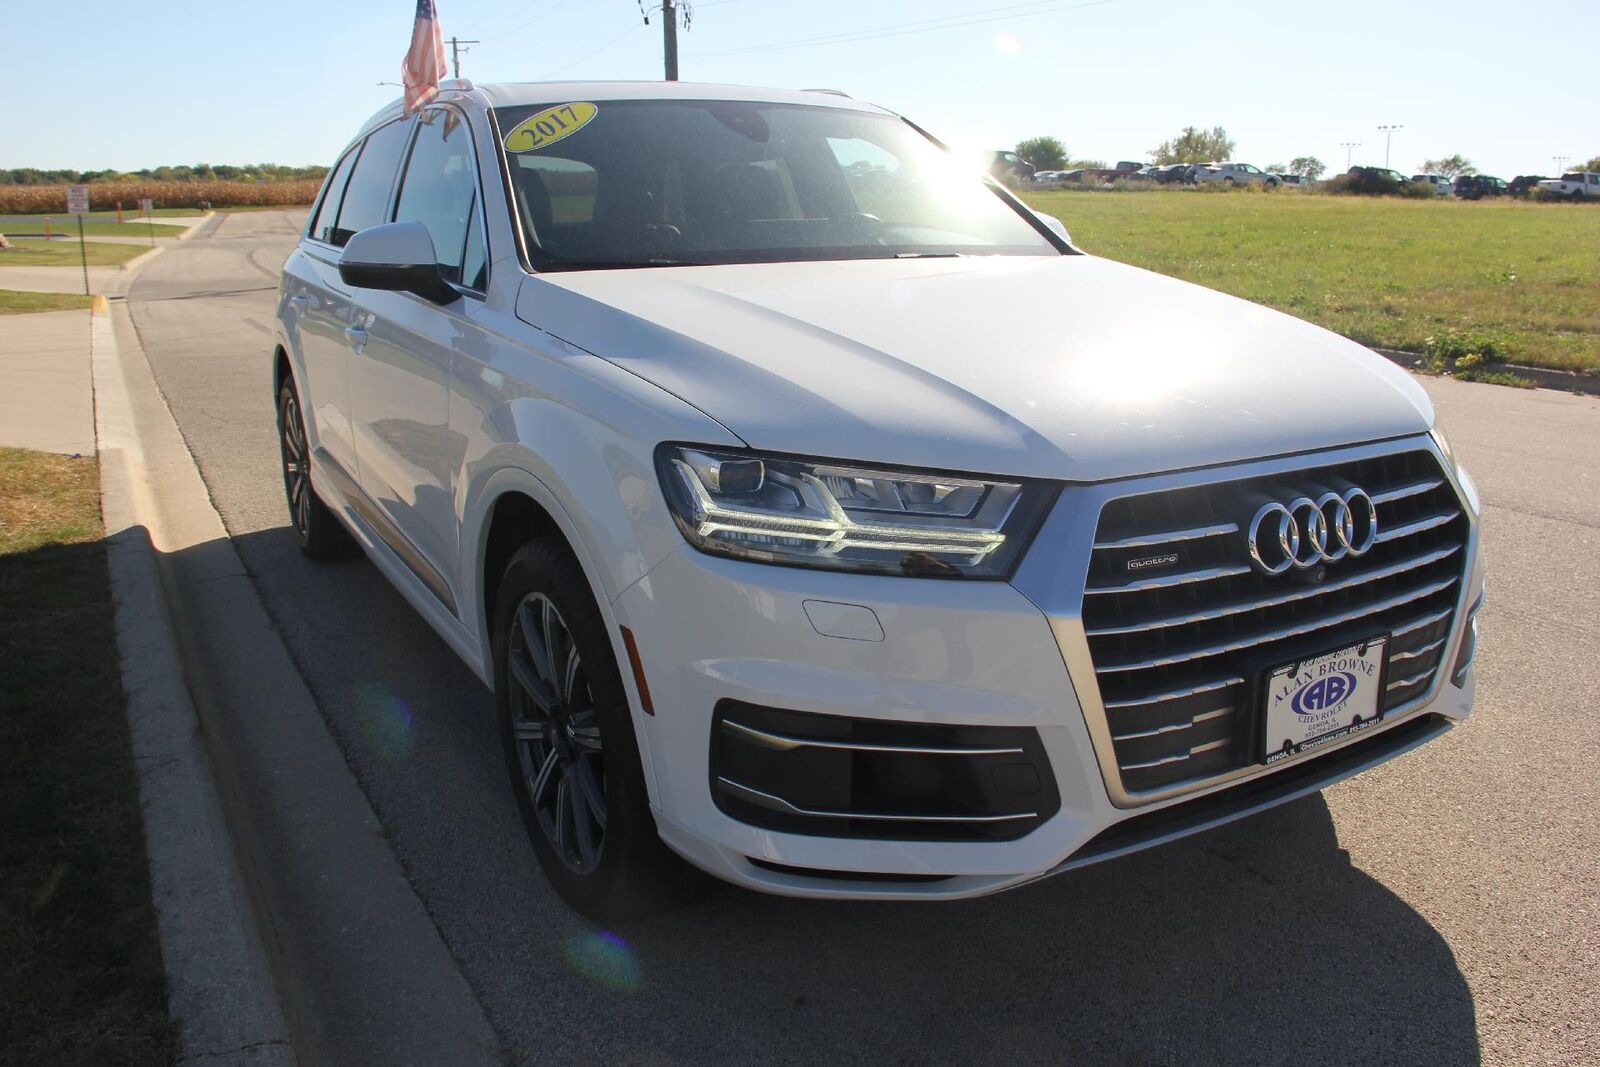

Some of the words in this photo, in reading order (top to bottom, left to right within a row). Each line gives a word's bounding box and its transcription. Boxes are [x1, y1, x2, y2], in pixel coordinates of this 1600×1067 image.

[521, 106, 578, 146] 2017
[1130, 555, 1177, 568] quattro
[1274, 669, 1314, 707] ALAN
[1319, 658, 1376, 677] BROWNE
[1298, 700, 1348, 723] CHEVROLET
